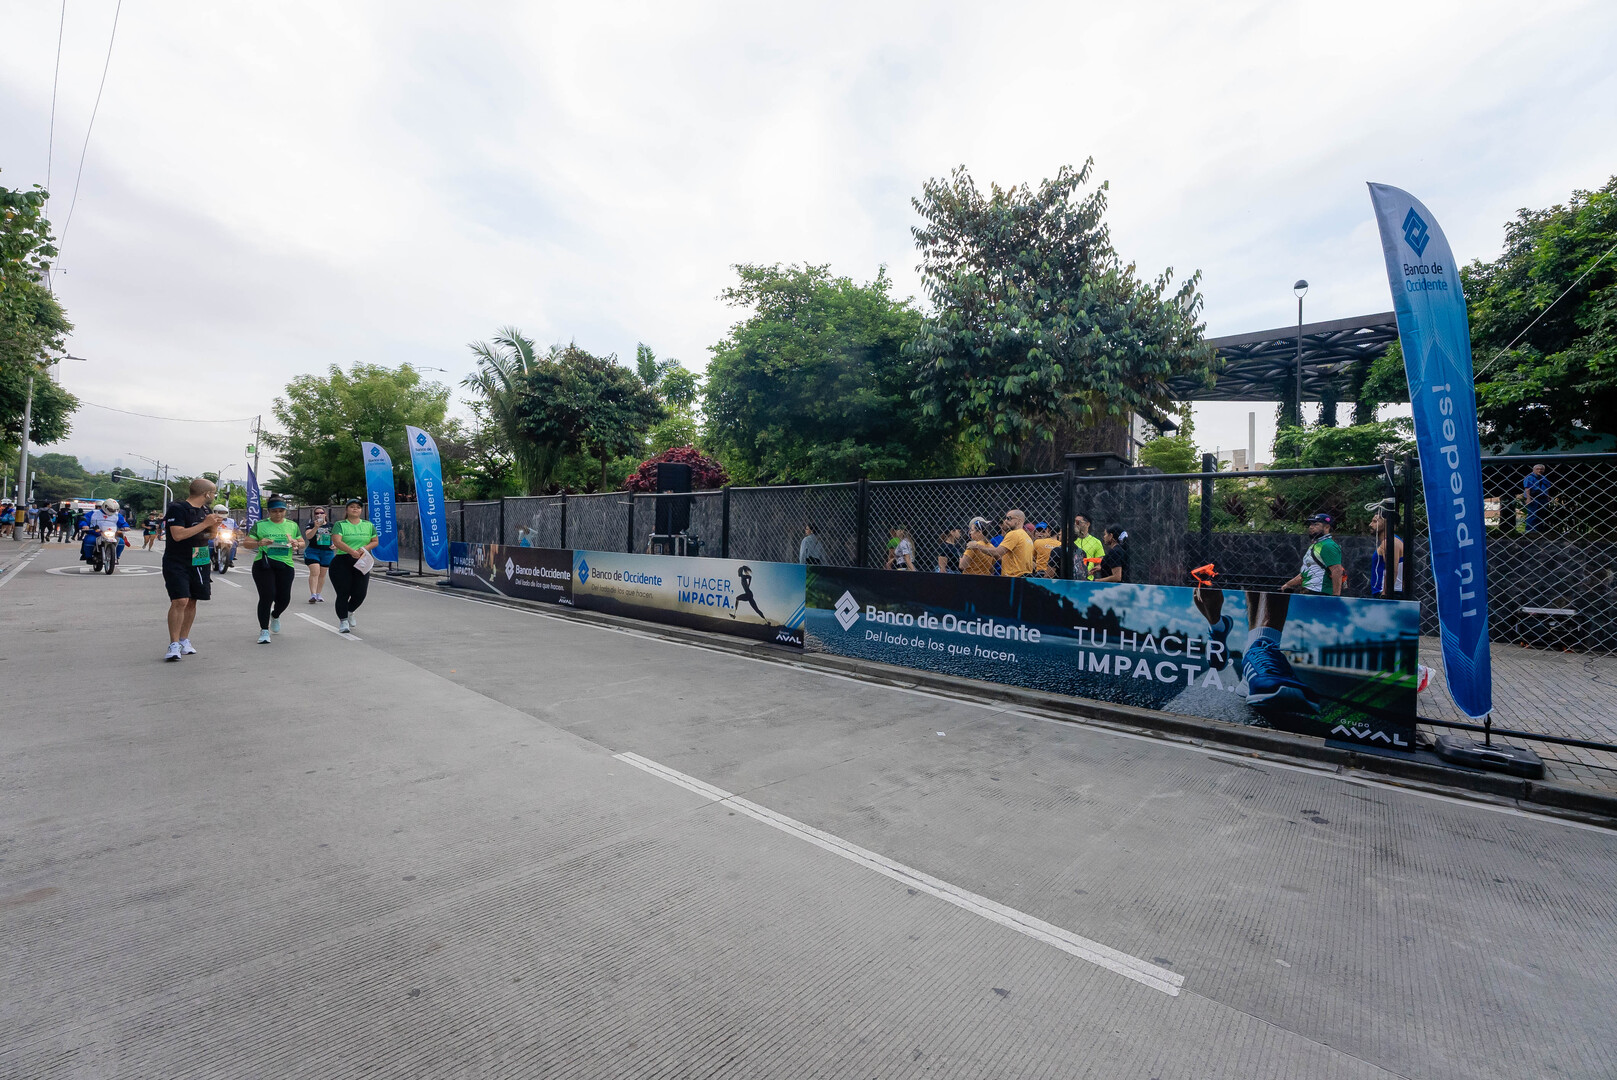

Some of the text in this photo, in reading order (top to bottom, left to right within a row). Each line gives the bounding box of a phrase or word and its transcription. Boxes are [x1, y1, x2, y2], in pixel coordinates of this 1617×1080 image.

[1403, 262, 1443, 276] Banco de
[1406, 278, 1448, 292] Occidente
[1432, 383, 1474, 548] puedes!
[372, 490, 381, 506] por
[382, 492, 391, 518] metas
[424, 477, 440, 547] ¡Eres fuerte!
[453, 556, 459, 565] TU
[515, 564, 571, 581] Banco de Occidente
[591, 567, 662, 587] Banco de Occidente
[521, 579, 530, 587] lado
[591, 583, 599, 591] Del
[599, 584, 609, 593] lado
[609, 586, 616, 594] de
[626, 589, 635, 597] que
[677, 575, 734, 595] TU HACER,
[678, 590, 734, 609] IMPACTA.
[865, 605, 1041, 643] Banco de Occidente
[775, 633, 802, 645] AVAL
[865, 630, 1019, 663] Del lado de los que hacen.
[1073, 626, 1234, 667] TU HACER,
[1077, 650, 1235, 692] IMPACTA.
[1340, 718, 1370, 728] Grupo
[1330, 724, 1408, 747] AVAL
